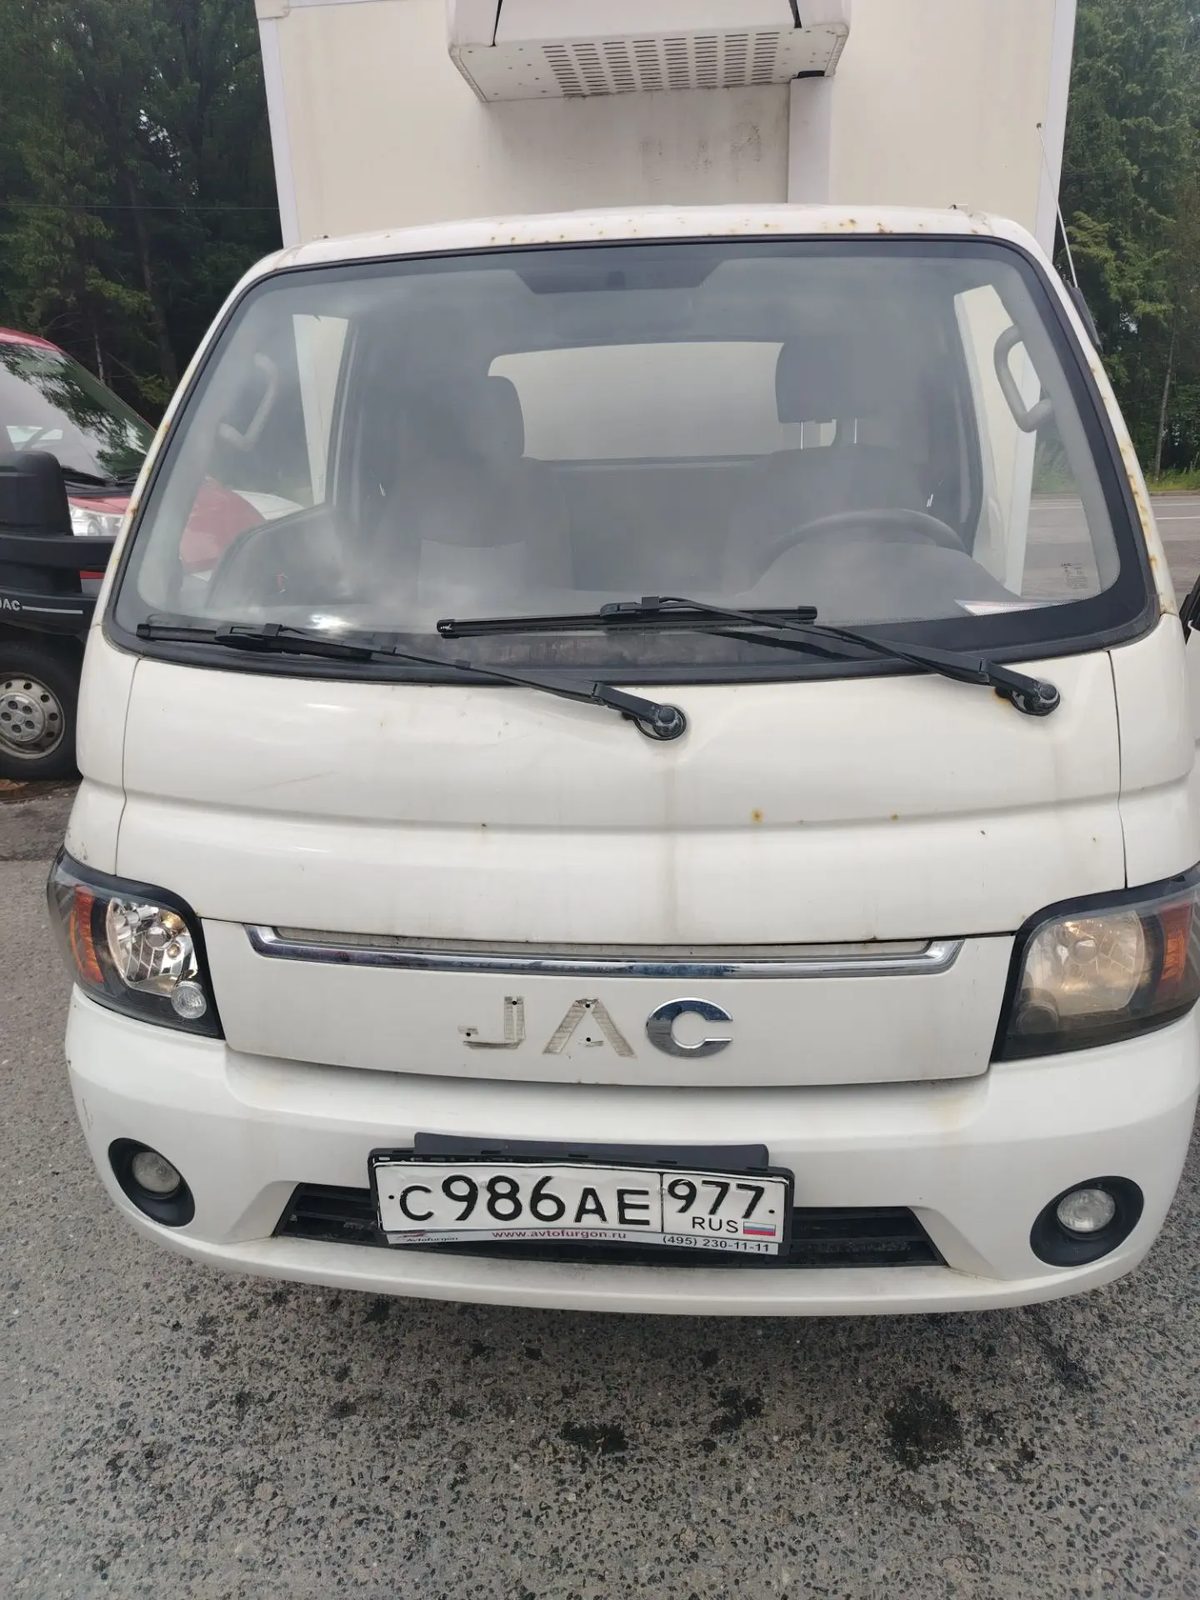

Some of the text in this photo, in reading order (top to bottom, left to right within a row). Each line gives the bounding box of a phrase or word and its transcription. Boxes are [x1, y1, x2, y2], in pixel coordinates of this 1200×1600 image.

[457, 996, 733, 1058] JAC
[399, 1174, 765, 1226] C986AE 977
[491, 1229, 627, 1239] www.avtofurgon.ru
[691, 1216, 739, 1234] RUS
[662, 1235, 770, 1252] (495) 230-11-11
